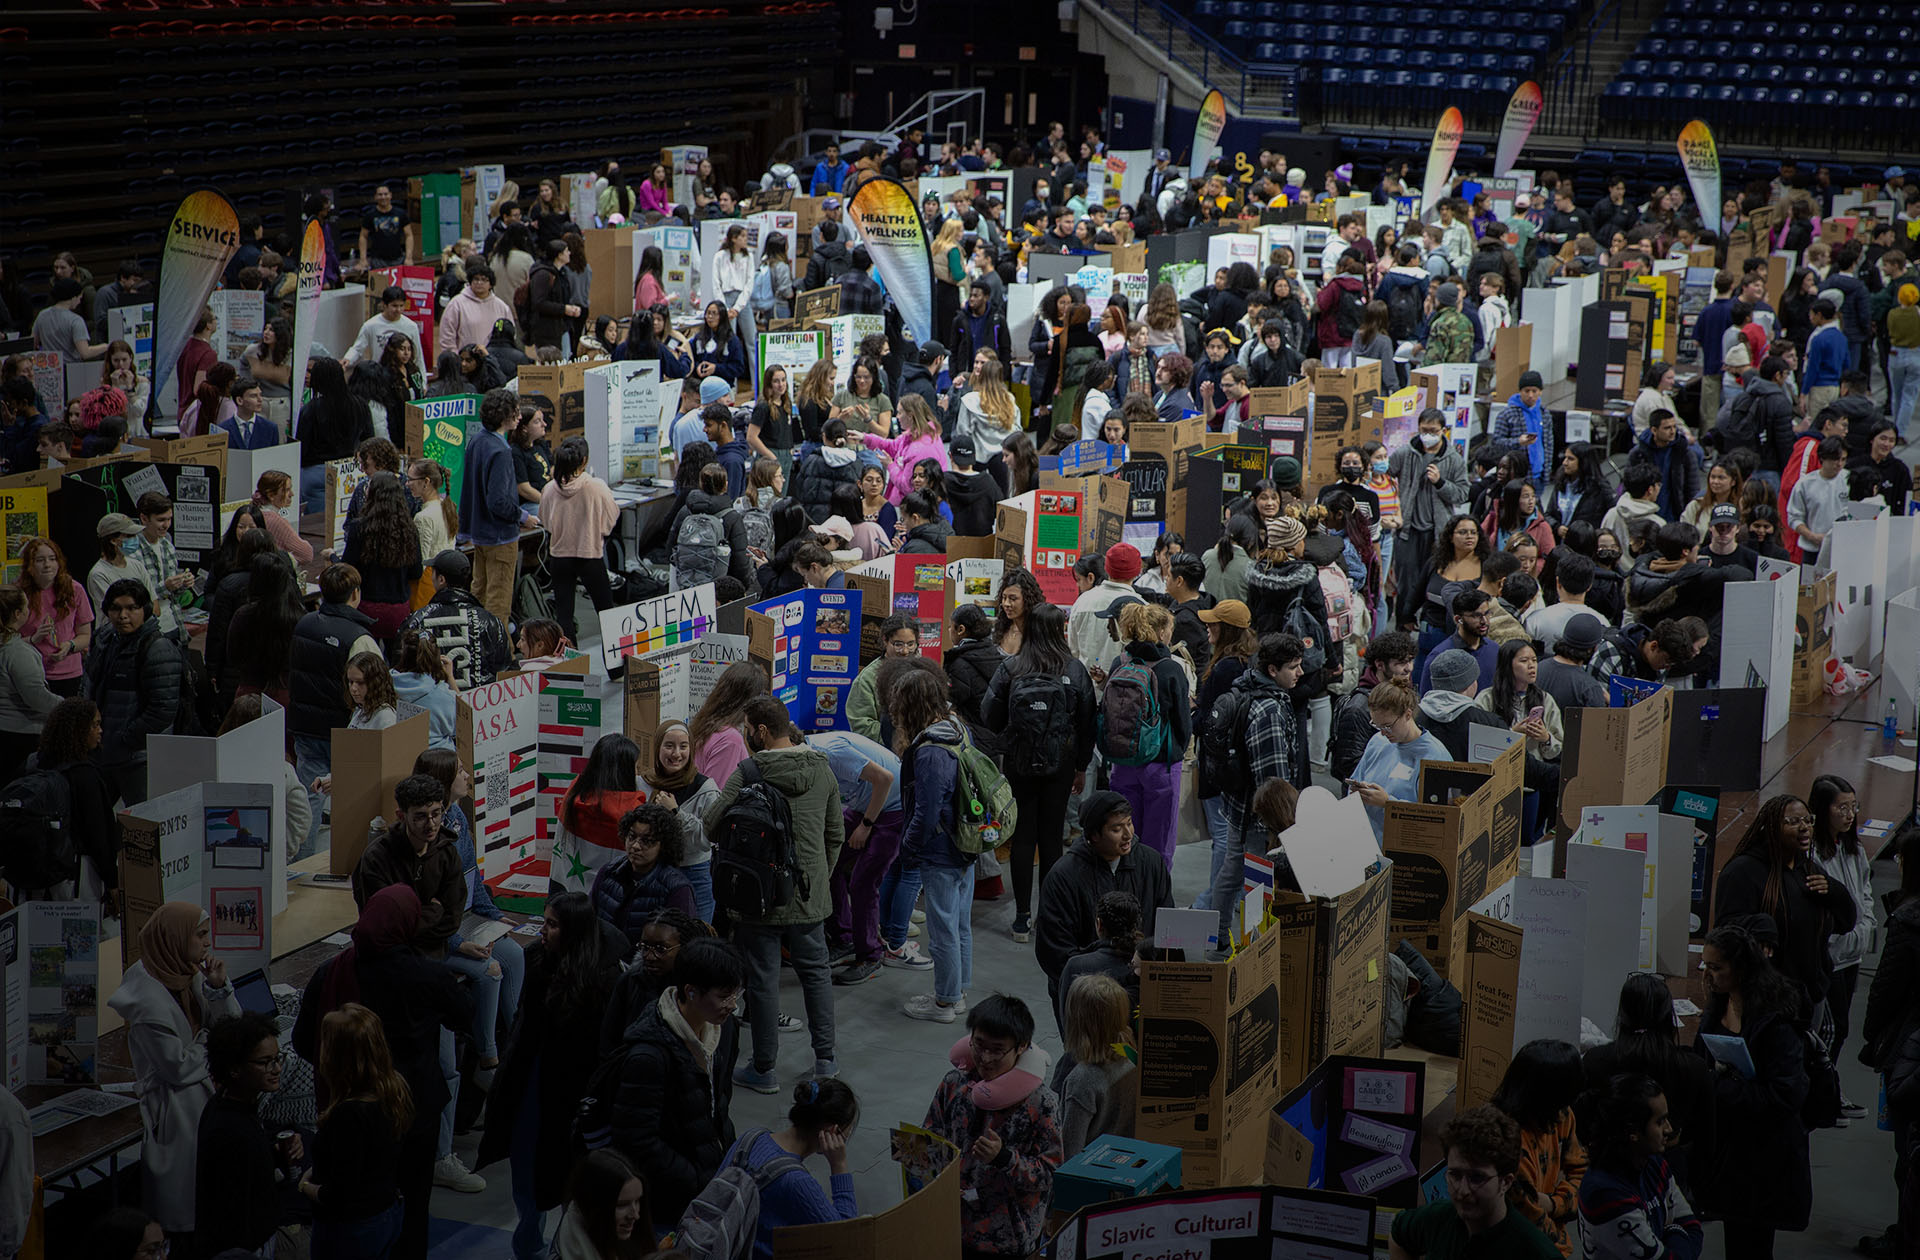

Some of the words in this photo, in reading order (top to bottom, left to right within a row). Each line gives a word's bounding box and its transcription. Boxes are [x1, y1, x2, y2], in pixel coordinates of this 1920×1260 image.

[862, 214, 904, 224] HEALTH
[908, 216, 914, 224] &
[174, 218, 236, 246] SERVICE
[866, 227, 916, 238] WELLNESS
[770, 334, 814, 344] NUTRITION
[1226, 450, 1244, 458] MEET
[1250, 452, 1263, 461] THE
[176, 504, 210, 512] Volunteer
[622, 590, 702, 636] oSTEM
[474, 708, 517, 744] ASA
[1338, 903, 1370, 949] BOARD
[1372, 882, 1386, 910] KIT
[1476, 932, 1517, 956] ArtSkills
[1477, 981, 1495, 994] Great
[1498, 989, 1512, 1001] For:
[1358, 1087, 1386, 1095] CAREER
[1370, 1162, 1402, 1182] pandas
[1102, 1224, 1154, 1247] Slavic
[1174, 1211, 1252, 1235] Cultural
